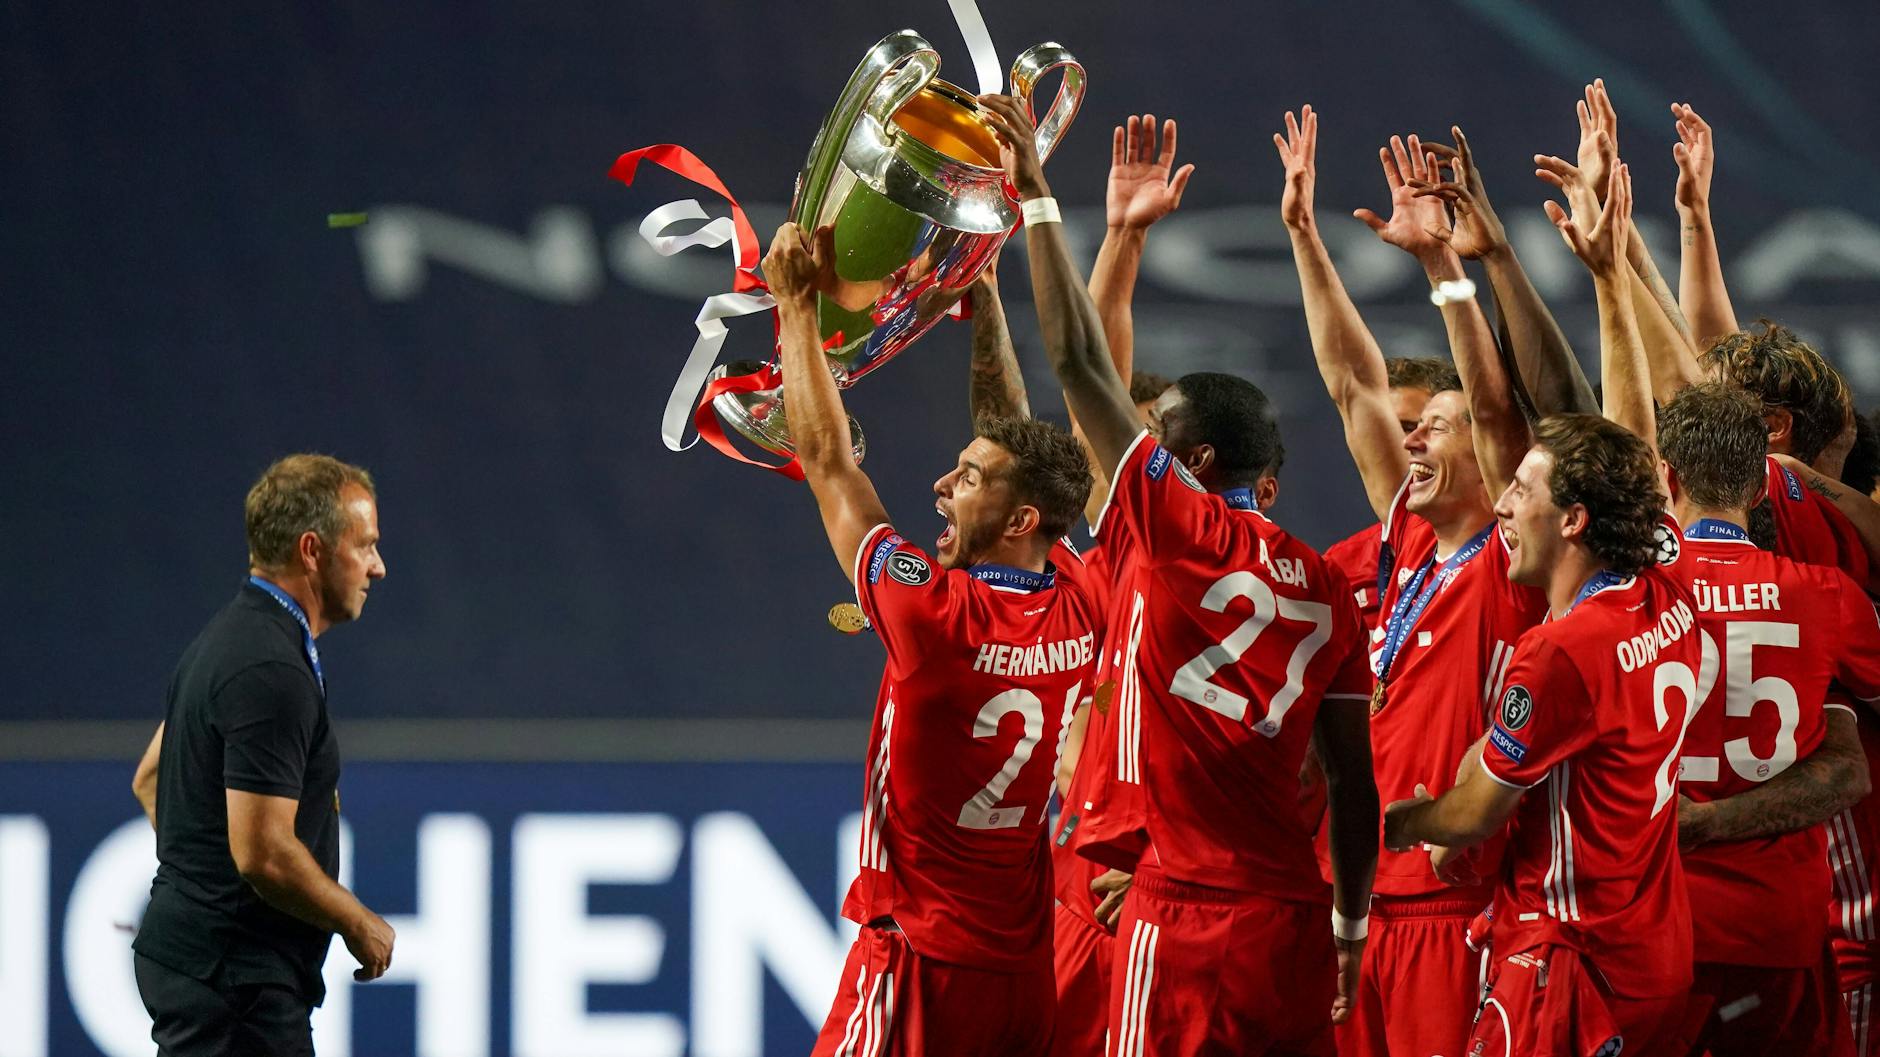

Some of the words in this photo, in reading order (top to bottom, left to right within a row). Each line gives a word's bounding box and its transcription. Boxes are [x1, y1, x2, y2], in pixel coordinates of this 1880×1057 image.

[1709, 525, 1737, 537] FINAL
[869, 541, 892, 583] RESPECT
[976, 571, 1001, 580] 2020
[1004, 573, 1040, 587] LISBON
[1409, 589, 1432, 623] LISBON
[1693, 578, 1781, 613] ÜLLER
[1169, 571, 1333, 738] 27
[1493, 729, 1525, 758] RESPECT
